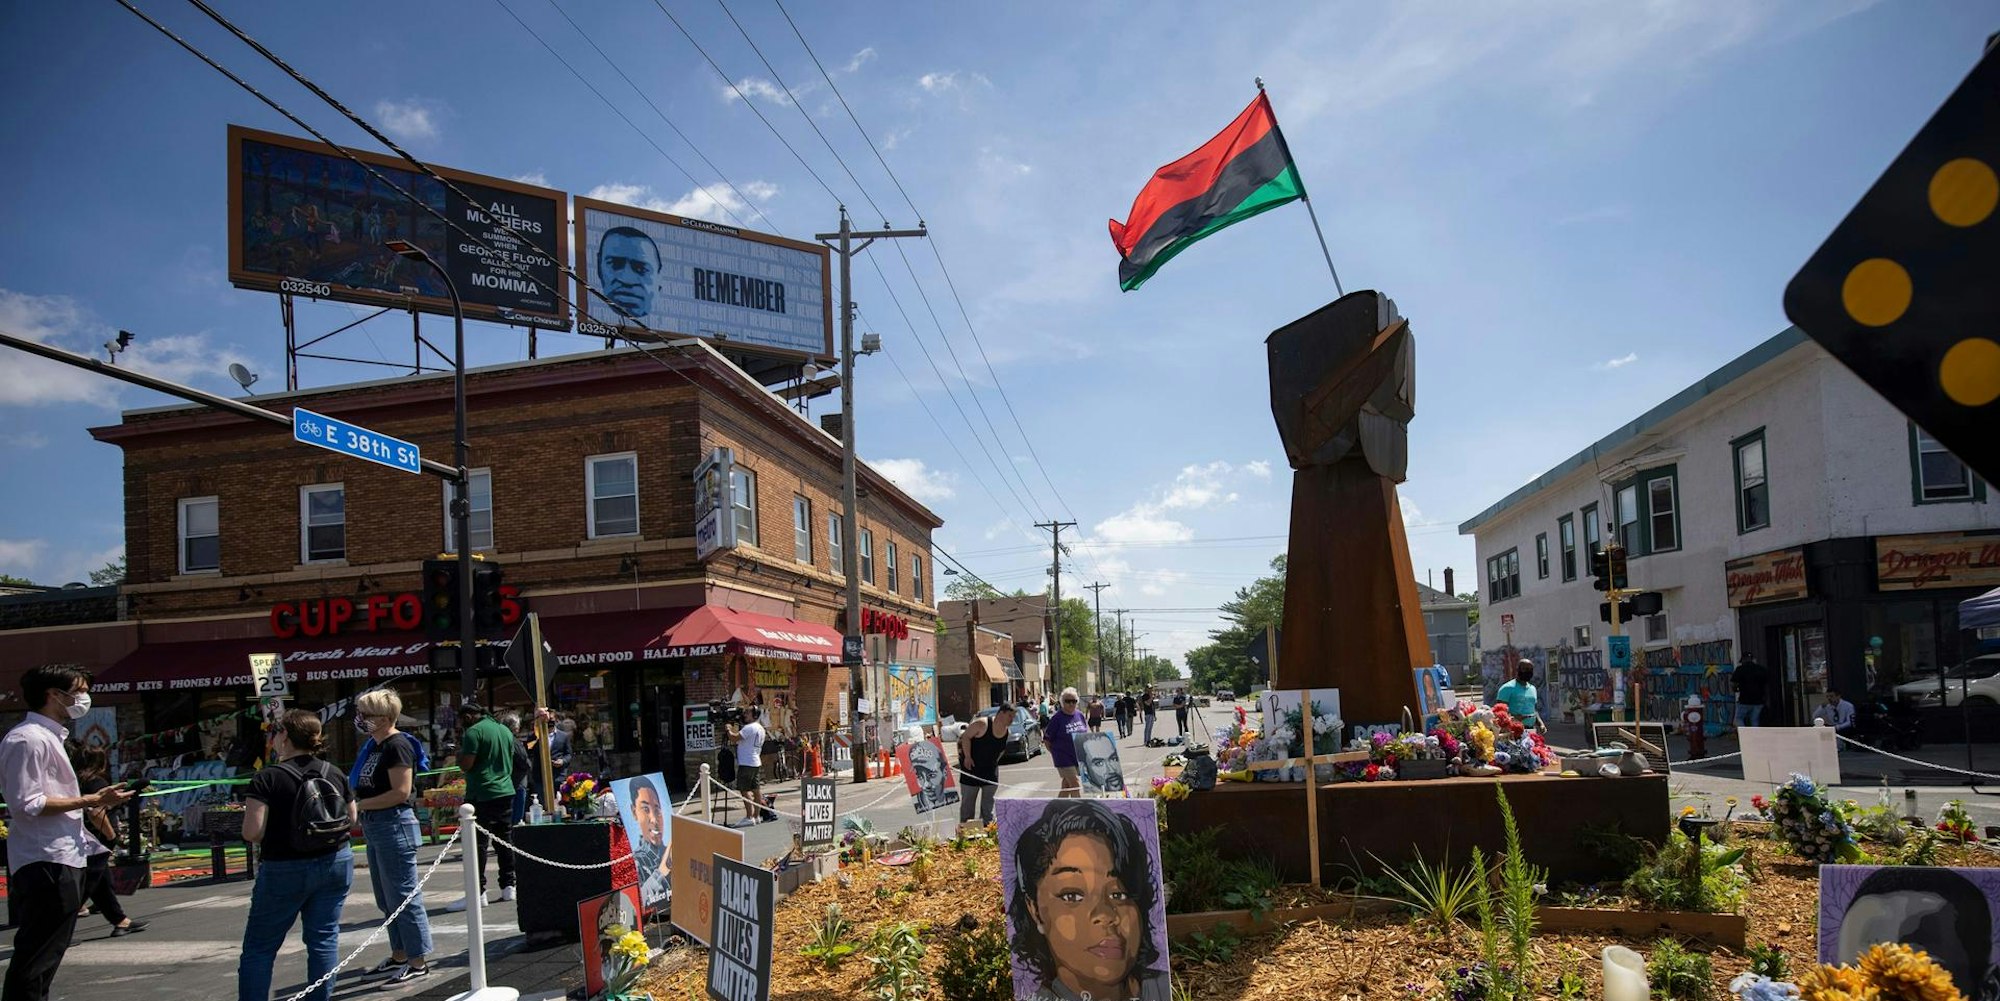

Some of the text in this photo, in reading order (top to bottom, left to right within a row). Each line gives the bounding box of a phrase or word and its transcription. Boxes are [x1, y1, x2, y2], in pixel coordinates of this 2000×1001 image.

[489, 202, 520, 217] ALL
[493, 241, 518, 251] WHEN
[489, 267, 522, 279] FOR HIS
[280, 280, 331, 297] 032540
[471, 272, 539, 296] MOMMA
[693, 267, 786, 314] REMEMBER
[326, 424, 417, 467] E 38th St
[1880, 548, 1972, 588] Dragon
[1729, 555, 1803, 602] Dragon Wok
[270, 586, 522, 640] CUP FOS
[284, 649, 345, 663] Fresh
[346, 645, 403, 660] Meat
[404, 641, 430, 655] &
[558, 644, 727, 666] XICAN FOOD HALAL MEAT
[253, 658, 281, 668] SPEED
[257, 667, 279, 676] LIMIT
[90, 681, 130, 693] STAMPS
[136, 680, 164, 691] KEYS
[169, 677, 211, 689] PHONES
[212, 677, 222, 687] &
[305, 669, 329, 681] BUS
[330, 668, 369, 680] CARDS
[377, 664, 431, 677] ORGANIC
[257, 677, 285, 693] 25
[686, 723, 713, 740] FREE
[686, 738, 714, 750] PALESTINE
[806, 783, 832, 801] BLACK
[809, 804, 830, 821] LIVES
[803, 824, 833, 843] MATTER
[720, 866, 760, 922] BLACK
[721, 910, 754, 965] LIVES
[711, 949, 759, 1001] MATTER
